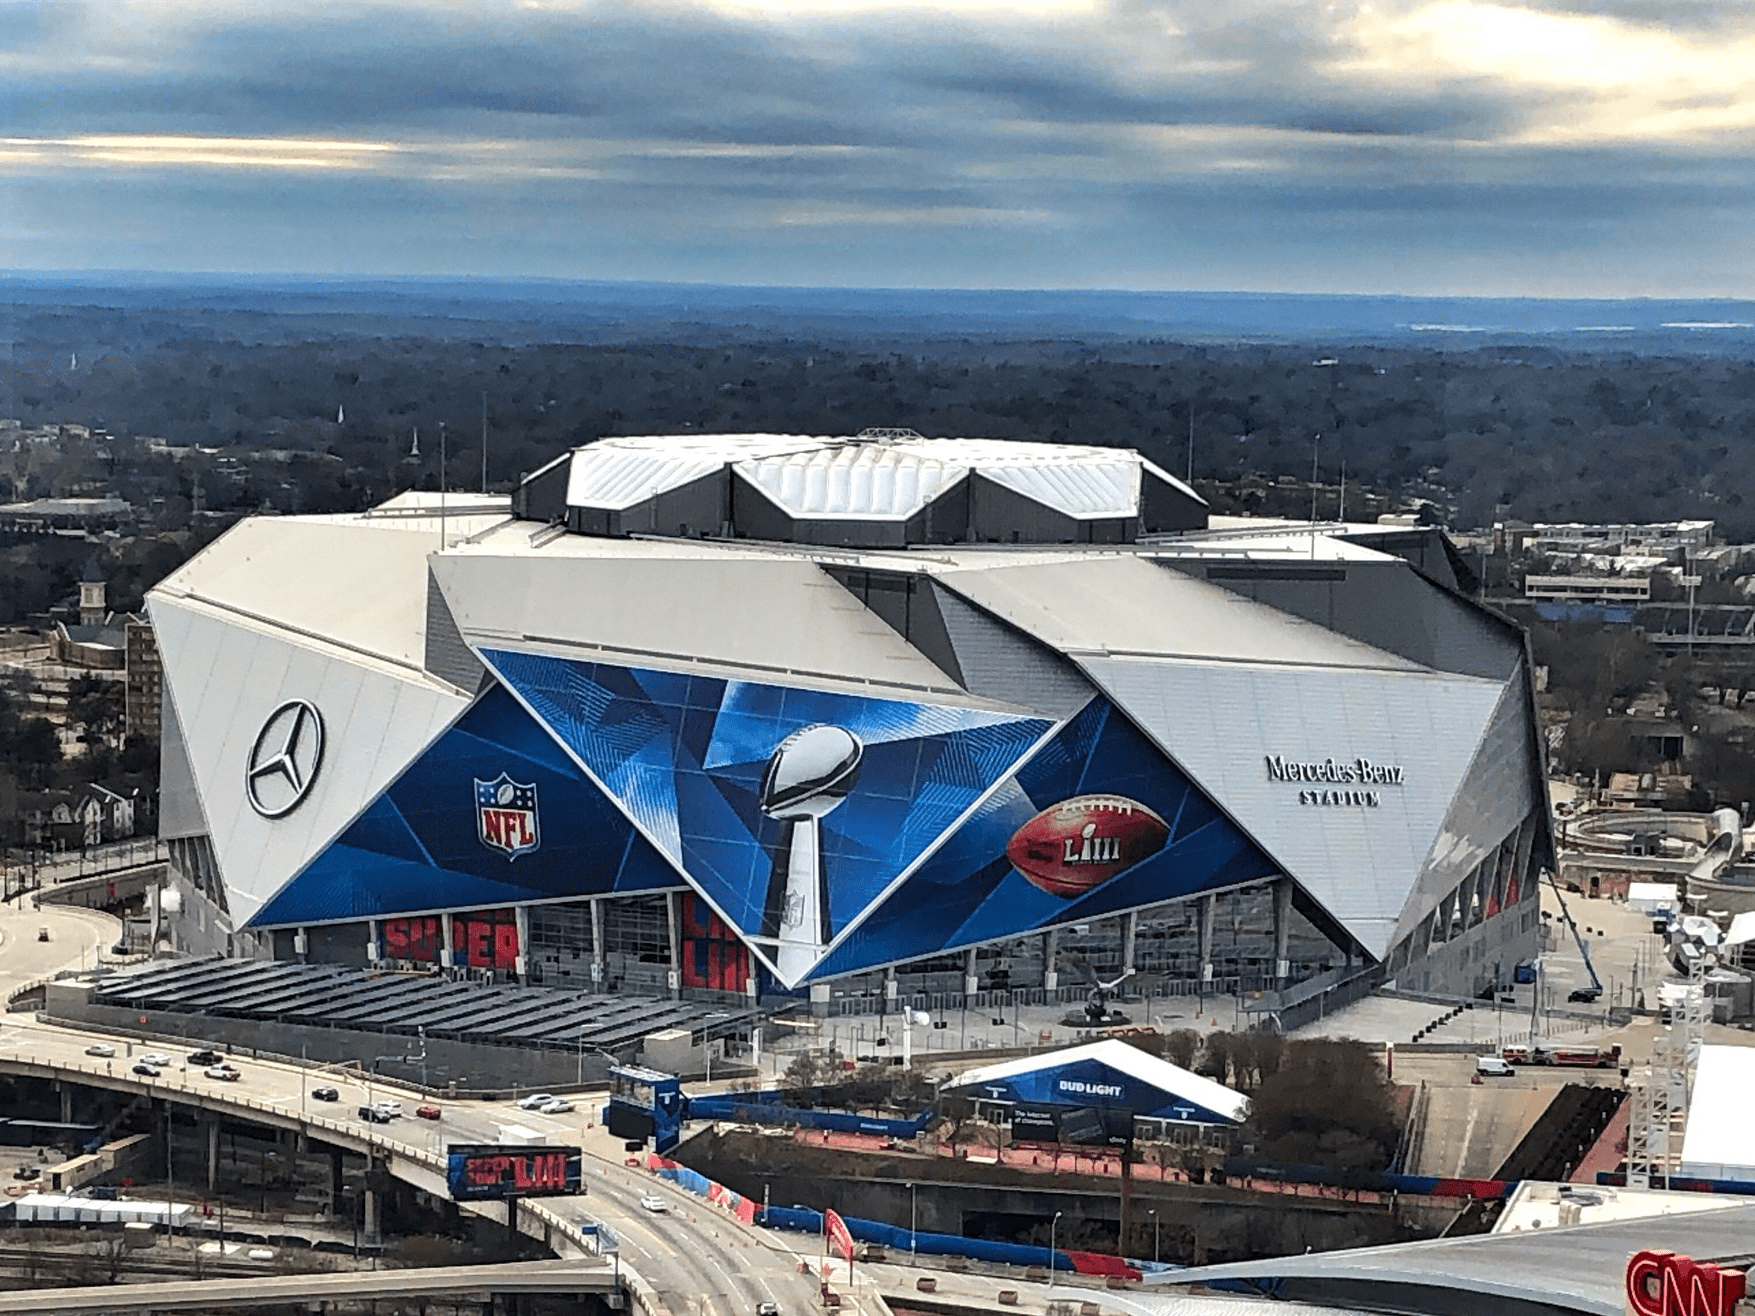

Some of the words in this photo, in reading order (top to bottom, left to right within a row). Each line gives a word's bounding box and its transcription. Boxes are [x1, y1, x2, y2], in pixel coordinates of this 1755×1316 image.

[1264, 755, 1405, 785] Mercedes-Benz
[1299, 790, 1381, 807] STADIUM
[482, 809, 534, 848] NFL
[1063, 828, 1121, 862] LIII
[1060, 1080, 1085, 1092] BUD
[1086, 1083, 1122, 1097] LIGHT
[1627, 1249, 1746, 1316] CNN
